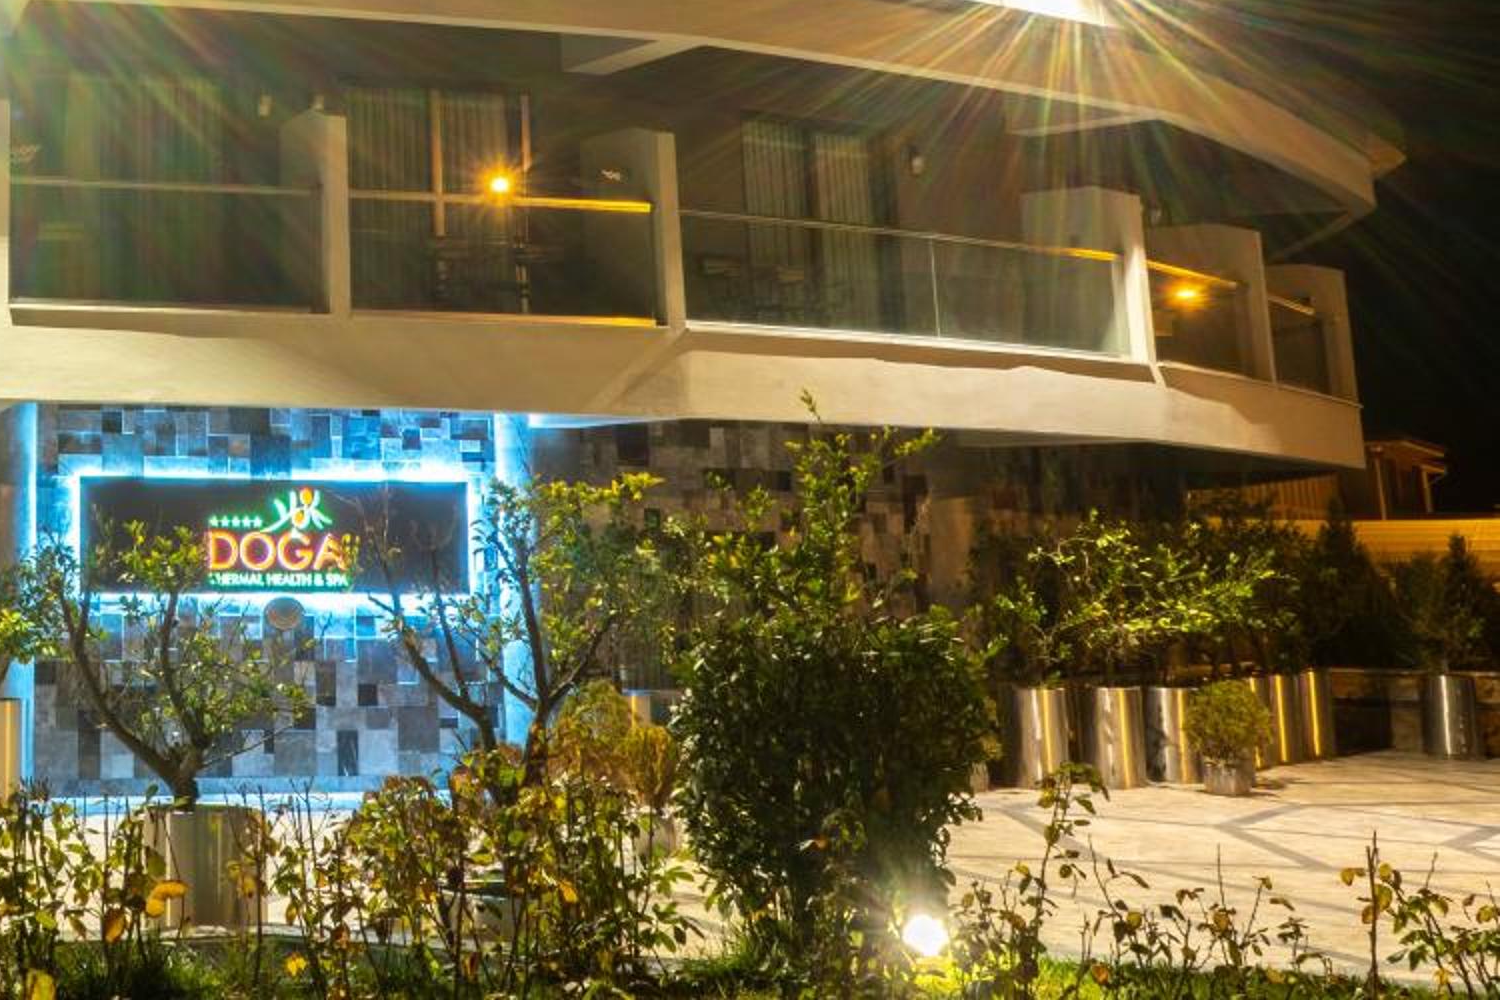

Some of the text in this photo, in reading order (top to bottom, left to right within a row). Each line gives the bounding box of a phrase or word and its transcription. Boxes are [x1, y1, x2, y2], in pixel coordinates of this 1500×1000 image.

[266, 573, 312, 587] HEALTH
[314, 573, 325, 587] &
[326, 573, 349, 587] SPA
